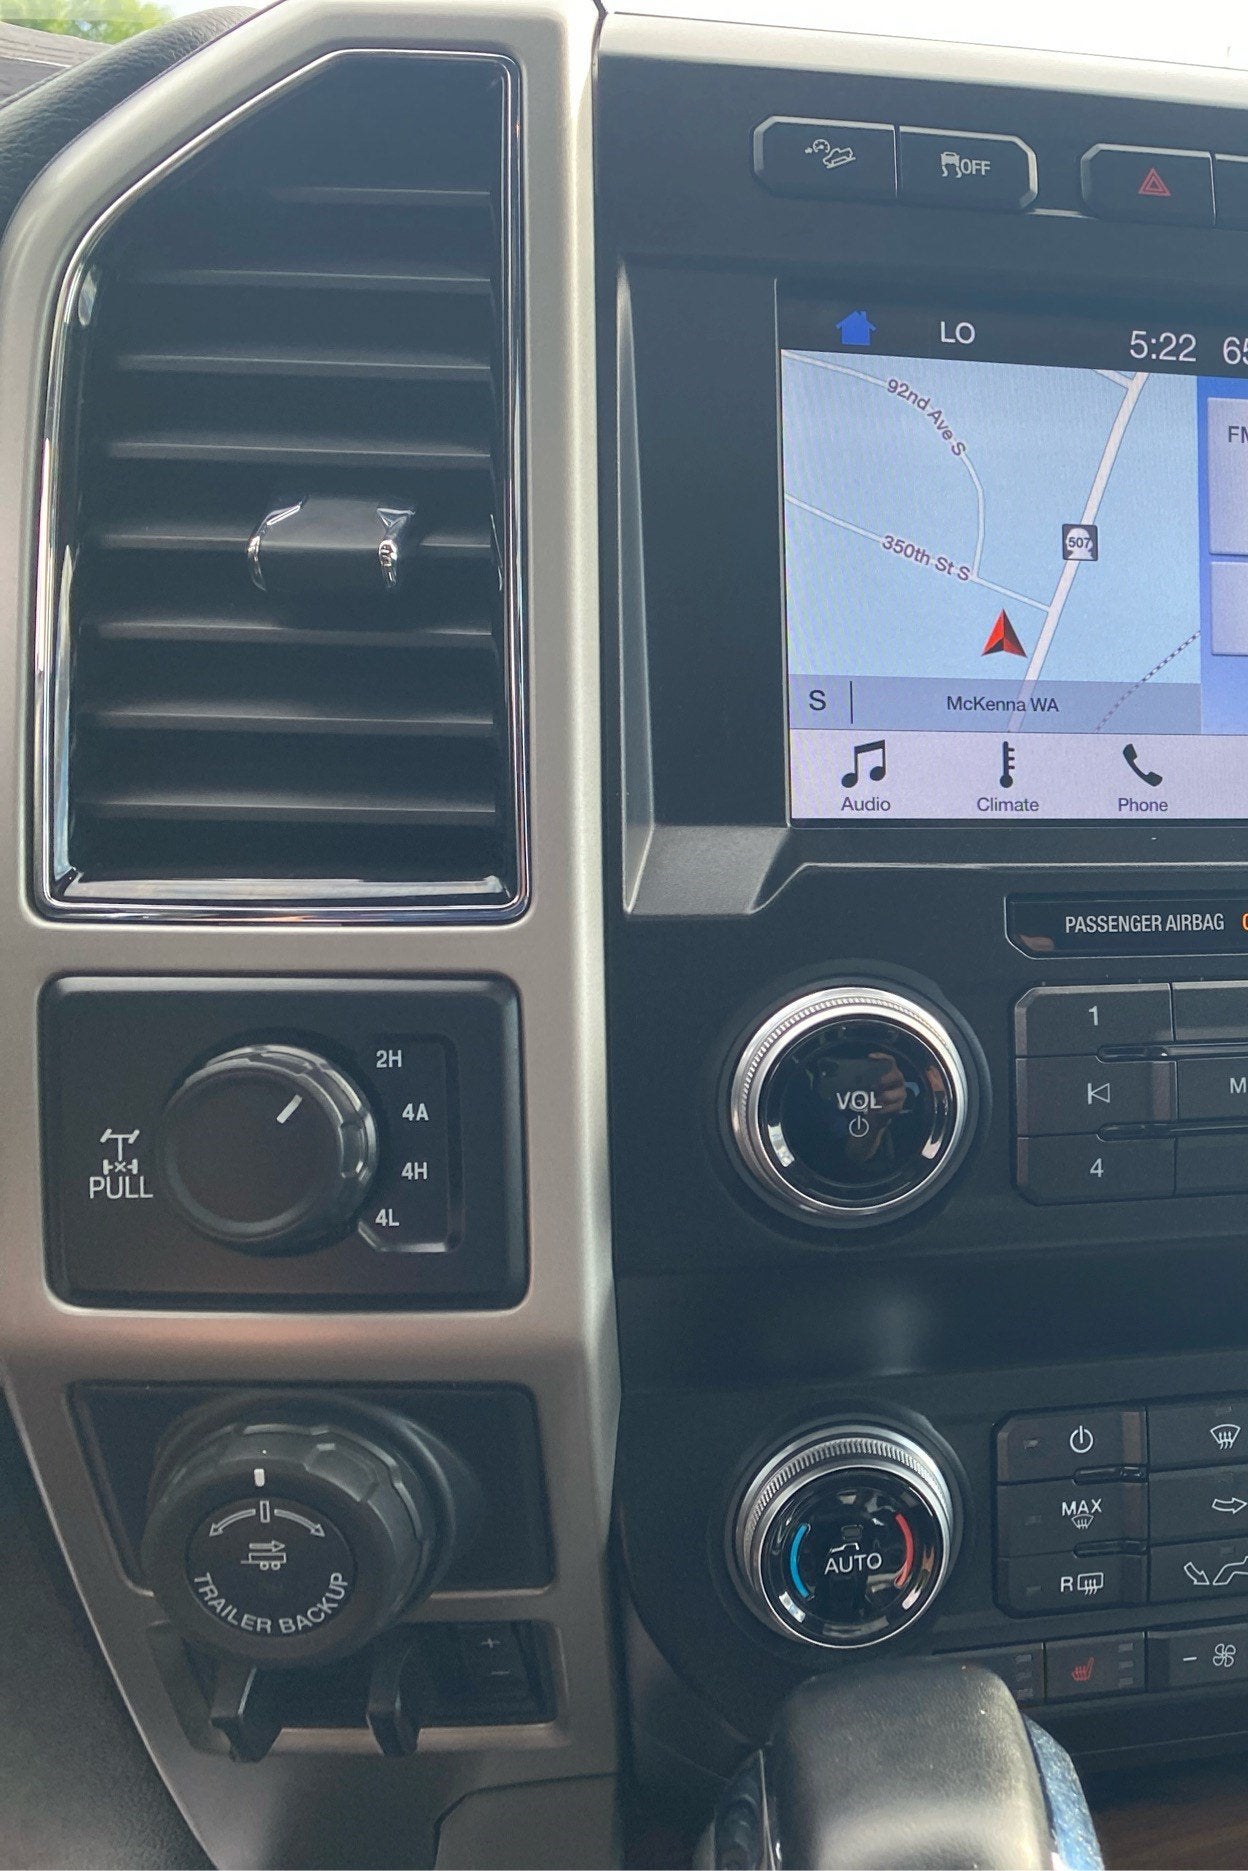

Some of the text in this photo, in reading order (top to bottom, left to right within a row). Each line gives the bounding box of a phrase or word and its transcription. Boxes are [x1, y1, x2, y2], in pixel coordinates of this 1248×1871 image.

[961, 158, 991, 176] OFF
[939, 320, 976, 345] LO
[1128, 330, 1197, 363] 5:22
[886, 377, 967, 457] 92nd Ave S
[1067, 535, 1092, 550] 507
[881, 534, 972, 582] 350th St S
[808, 689, 827, 712] S
[946, 695, 1060, 713] McKenna WA
[841, 796, 891, 813] Audio
[976, 796, 1040, 813] Climate
[1117, 797, 1169, 813] Phone
[1064, 914, 1162, 934] PASSENGER
[1165, 913, 1225, 933] AIRBAG
[1088, 1005, 1099, 1026] 1
[375, 1049, 403, 1069] 2H
[836, 1090, 883, 1112] VOL
[401, 1102, 430, 1122] 4A
[401, 1161, 429, 1181] 4H
[1089, 1158, 1105, 1178] 4
[88, 1176, 154, 1199] PULL
[374, 1207, 400, 1227] 4L
[1061, 1498, 1103, 1516] MAX
[824, 1552, 882, 1575] AUTO
[1060, 1576, 1074, 1592] R
[193, 1571, 349, 1635] TRAILER BACKUP
